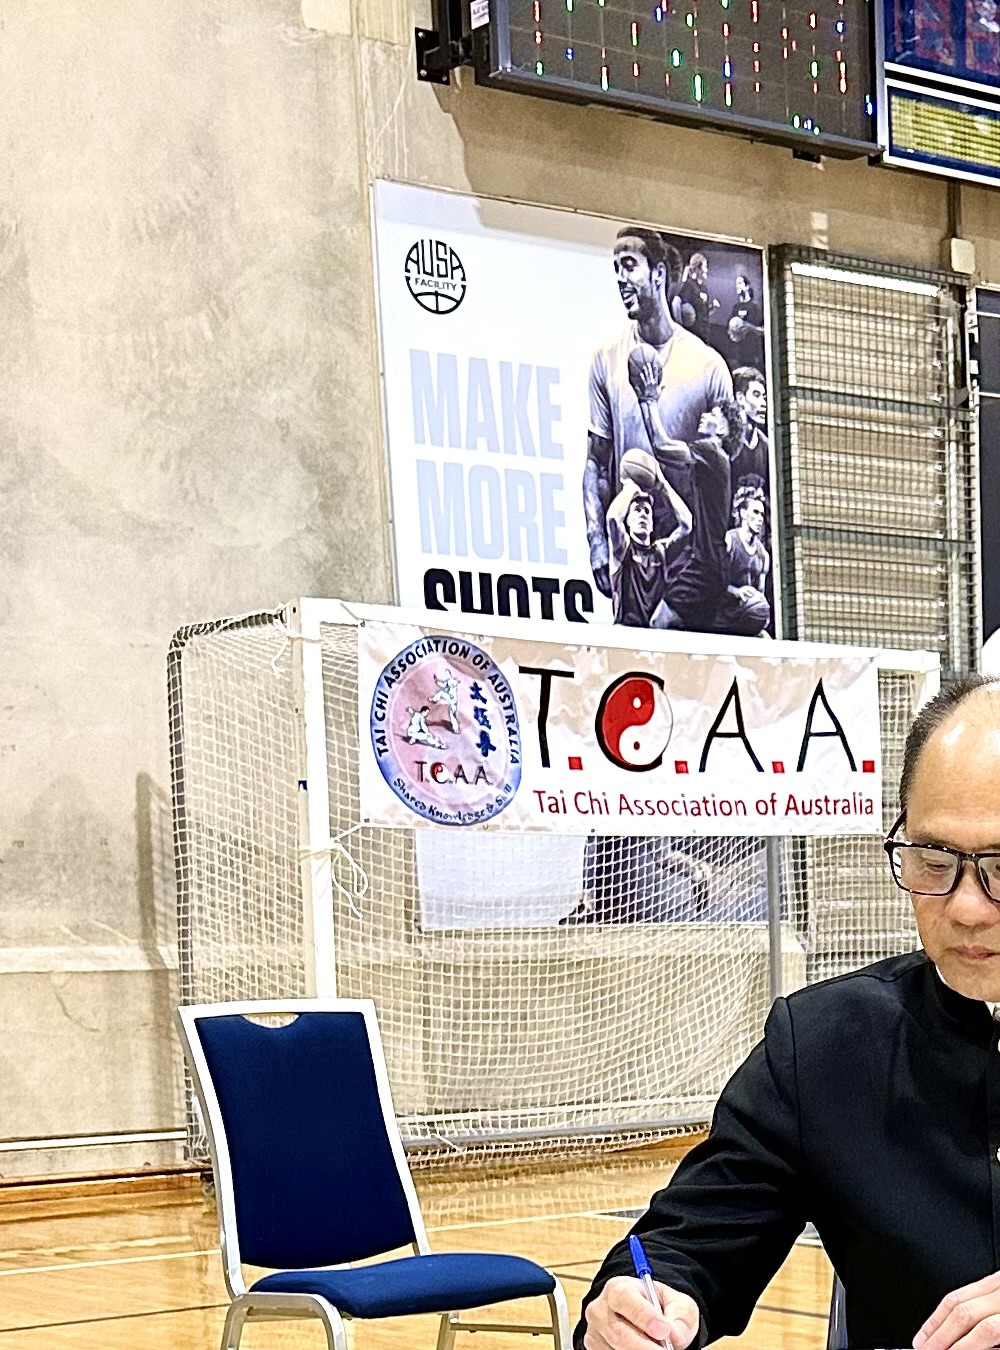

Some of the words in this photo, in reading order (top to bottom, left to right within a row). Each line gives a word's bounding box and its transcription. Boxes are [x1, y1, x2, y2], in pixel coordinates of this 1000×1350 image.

[405, 239, 466, 281] AUSA
[415, 277, 457, 291] FACILITY
[409, 348, 564, 460] MAKE
[416, 459, 568, 566] MORE
[384, 639, 470, 688] ASSOCIATION
[472, 654, 491, 671] OF
[375, 690, 389, 722] CHI
[488, 673, 520, 765] AUSTRALIA
[375, 728, 389, 758] TAI
[533, 789, 567, 815] Tai
[574, 791, 609, 816] Chi
[618, 793, 747, 817] Association
[756, 793, 779, 816] of
[784, 792, 874, 817] Australia
